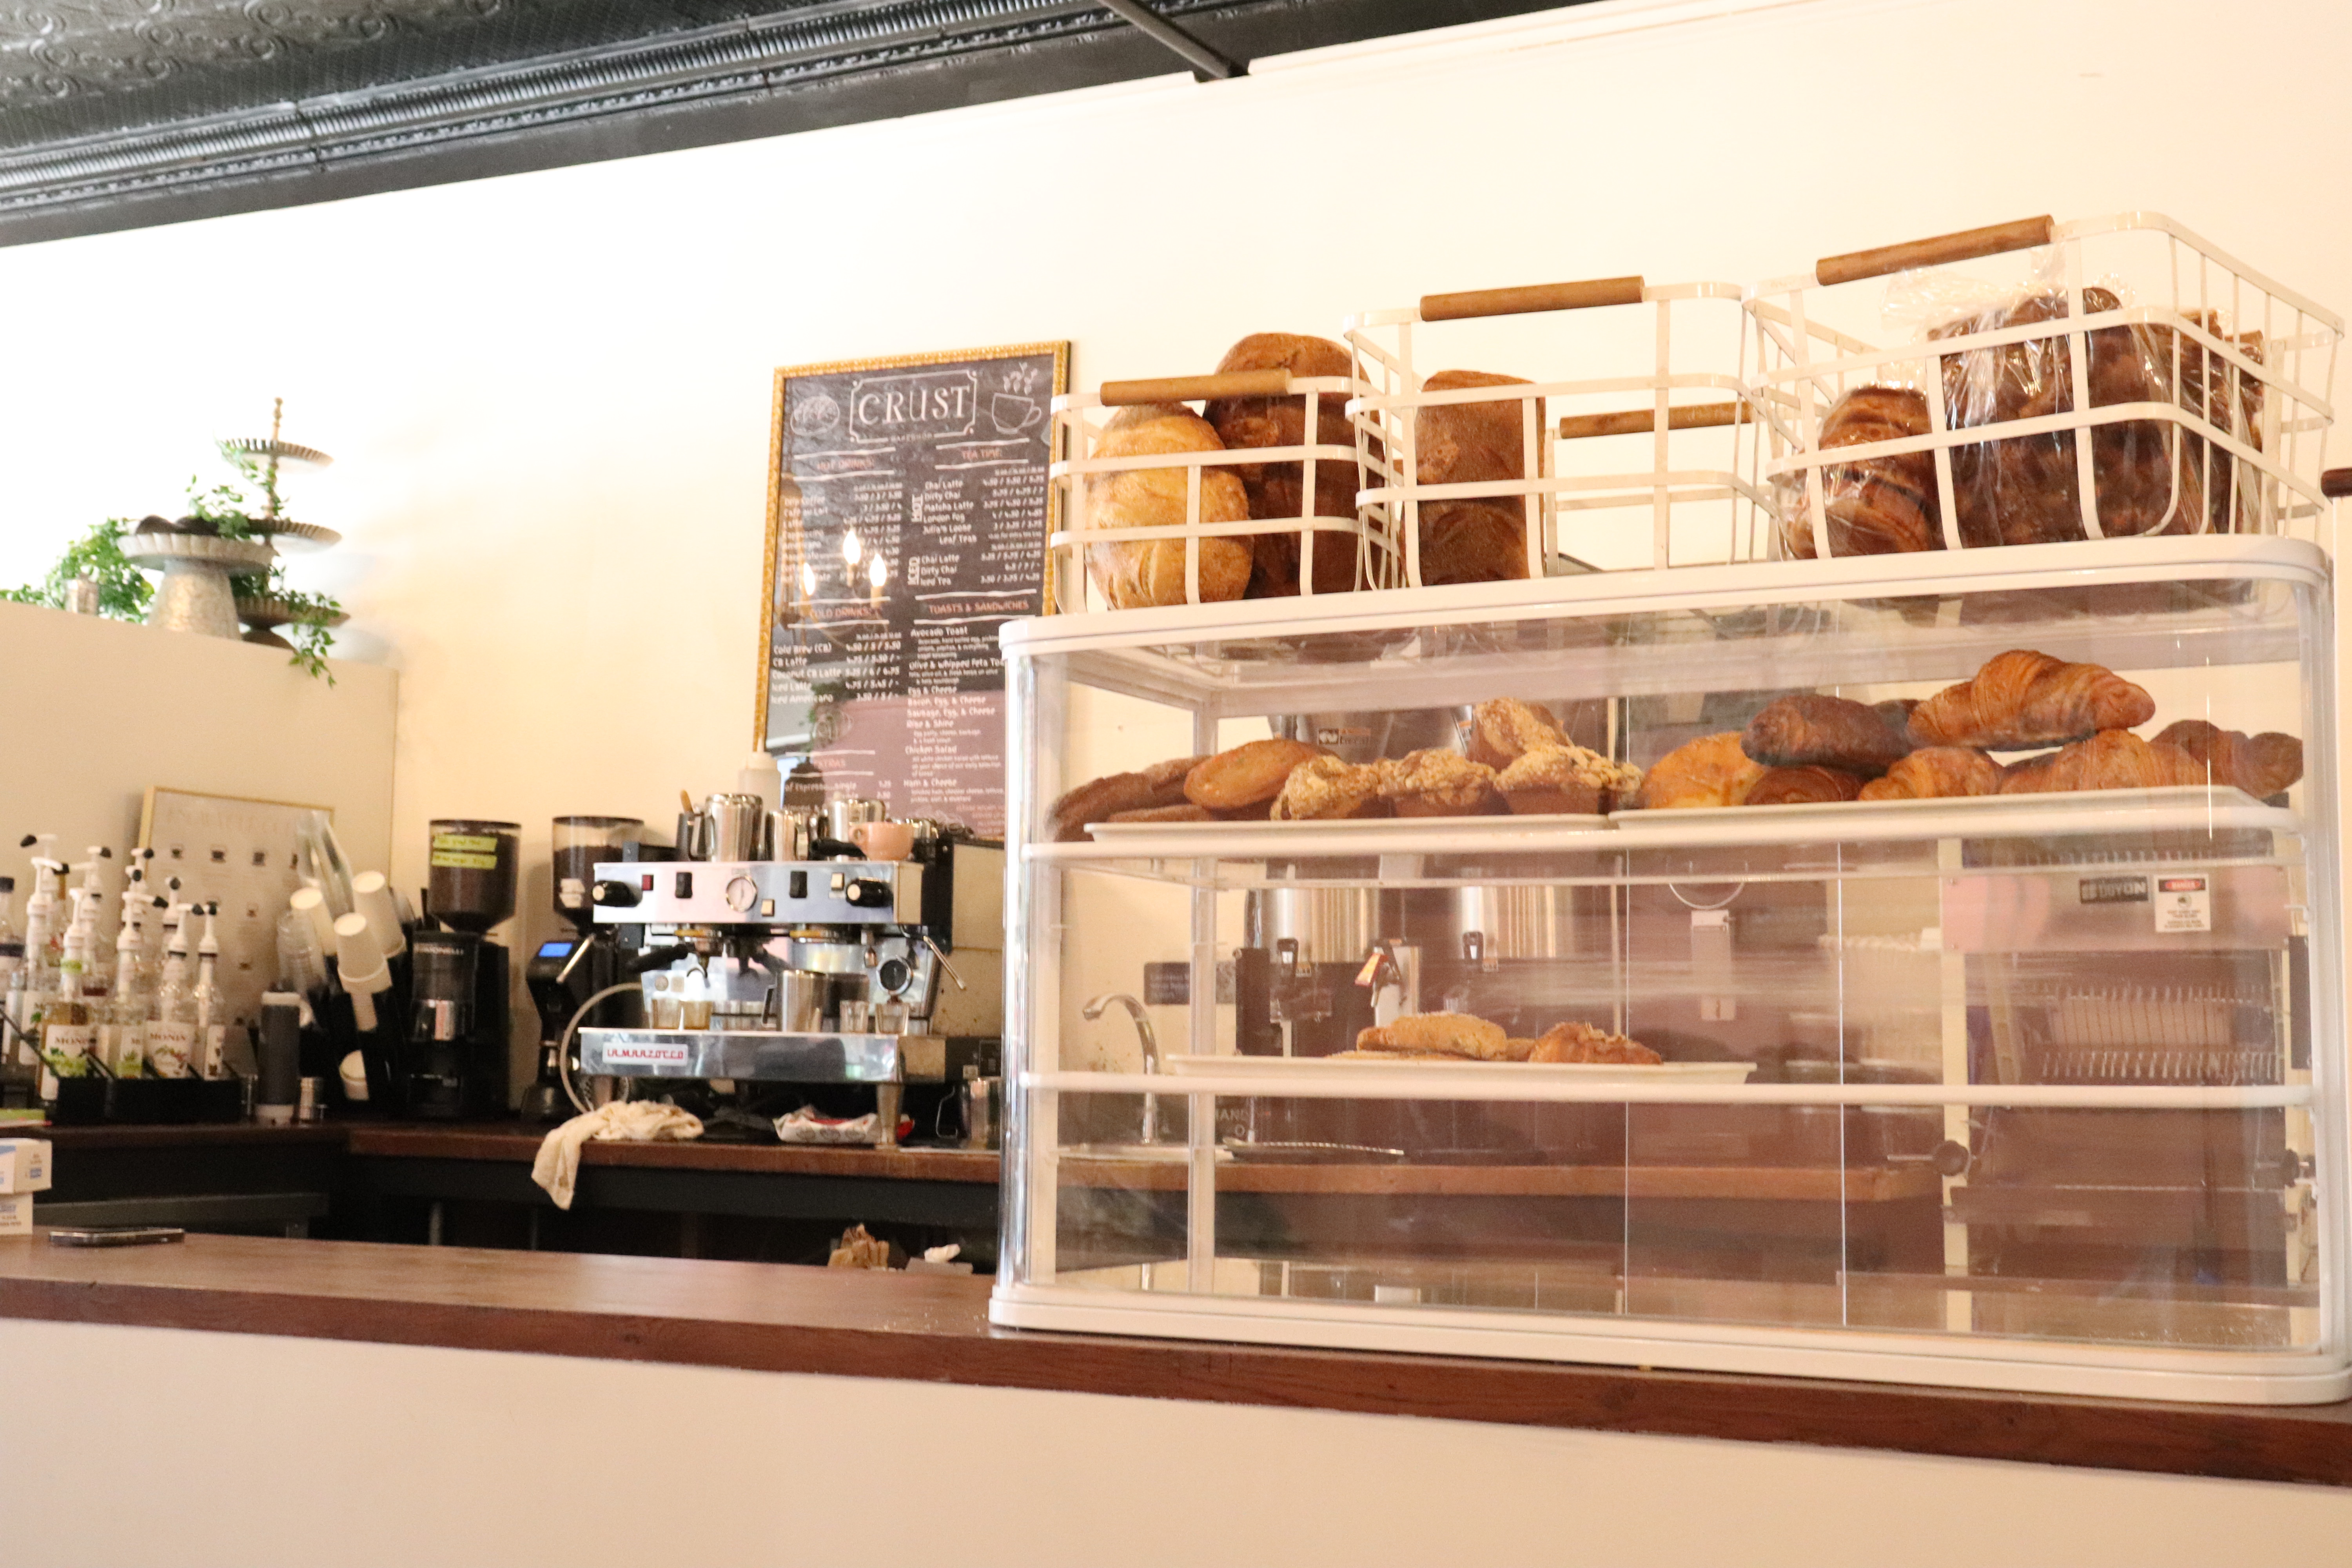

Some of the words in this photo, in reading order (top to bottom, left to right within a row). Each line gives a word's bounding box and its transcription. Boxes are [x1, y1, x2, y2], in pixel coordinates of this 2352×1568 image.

[858, 384, 970, 425] CRUST
[929, 604, 963, 614] TOASTS
[975, 600, 1029, 612] SANDWICHES
[911, 628, 943, 637] Avocado
[946, 626, 967, 635] Toast
[909, 661, 928, 670] Olive
[908, 686, 921, 697] Egg
[931, 685, 957, 695] Cheese
[960, 695, 986, 705] Cheese
[969, 706, 995, 716] Cheese
[933, 719, 954, 728] Shine
[905, 745, 933, 755] Chicken
[935, 745, 957, 754] Salad
[931, 778, 957, 787] Cheese
[607, 1049, 618, 1057] LA
[622, 1049, 683, 1059] MARZOCCO
